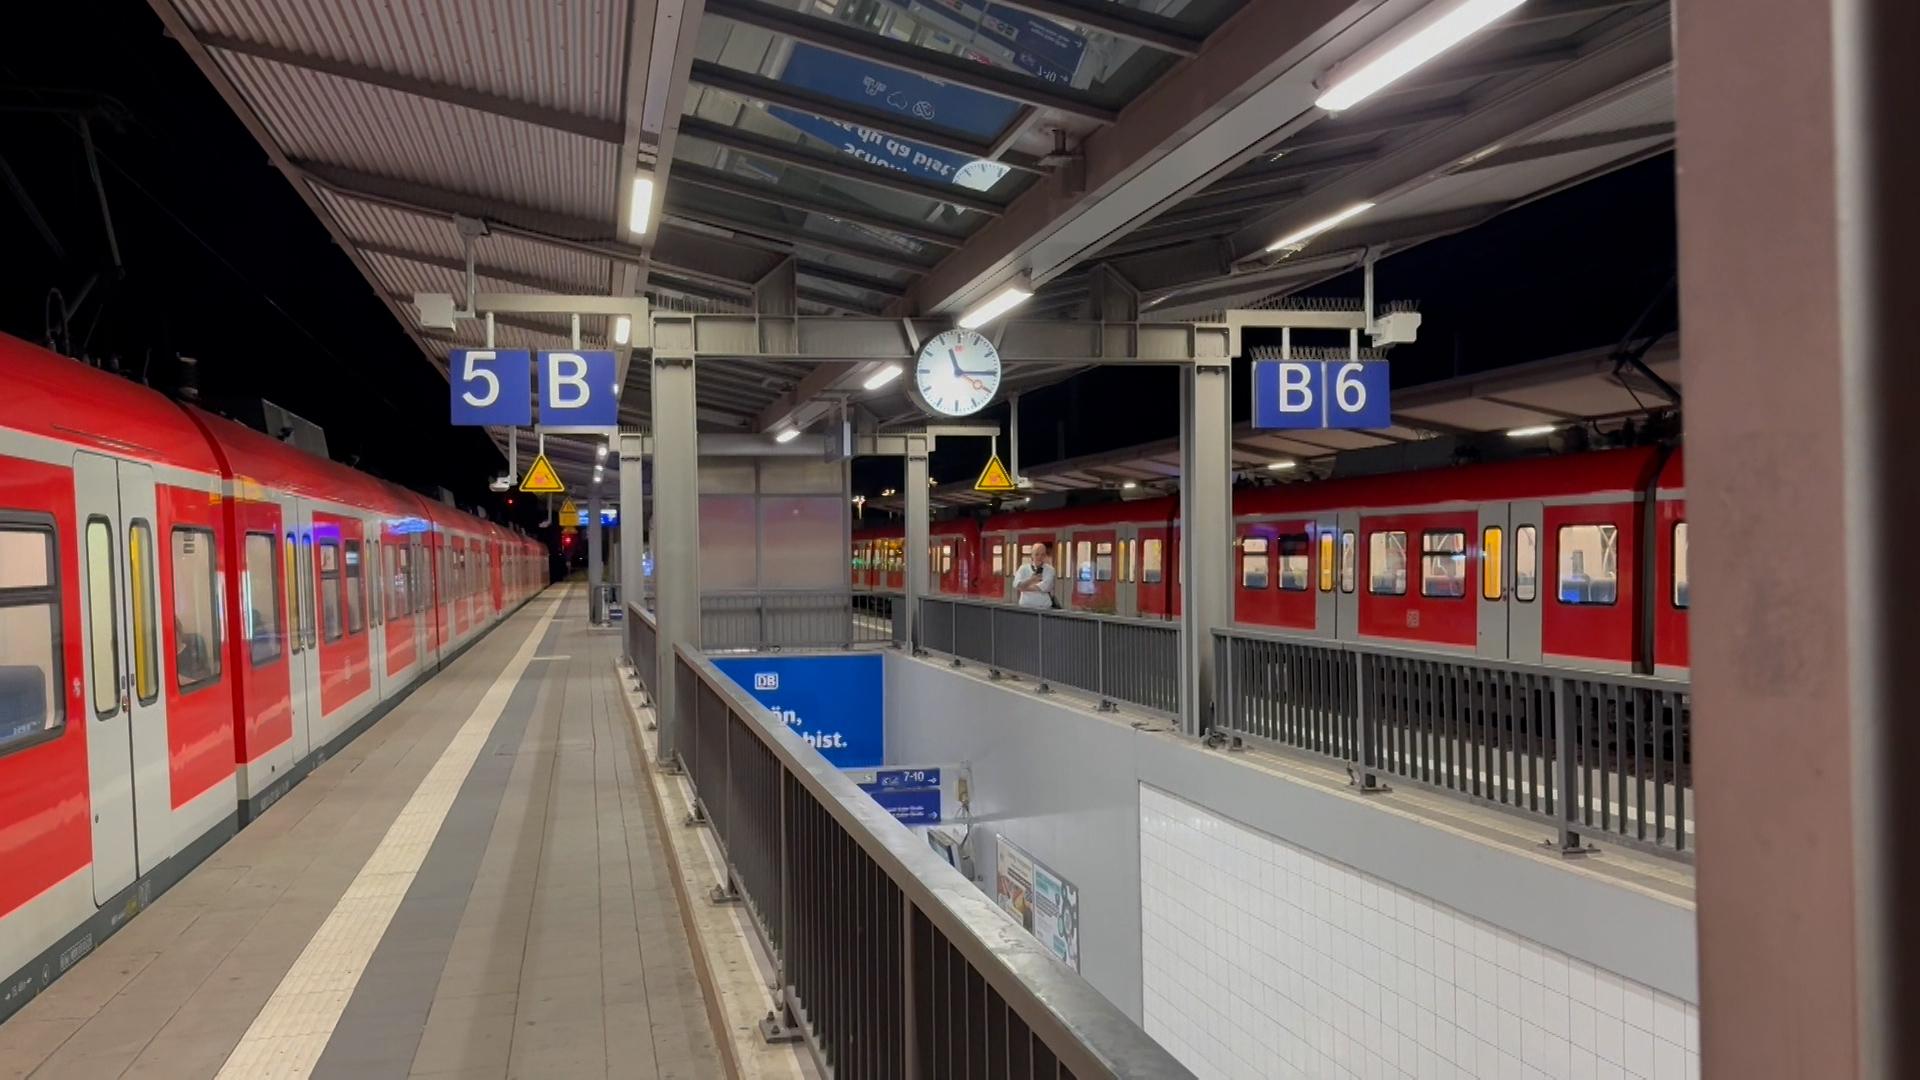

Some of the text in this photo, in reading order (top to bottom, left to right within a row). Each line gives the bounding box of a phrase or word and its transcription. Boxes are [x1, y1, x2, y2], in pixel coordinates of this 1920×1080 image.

[462, 351, 500, 407] 5
[548, 352, 590, 409] B
[1279, 362, 1313, 413] B
[1335, 362, 1367, 413] 6
[756, 673, 777, 689] DB
[802, 730, 848, 748] bist.
[903, 771, 925, 782] 7-10
